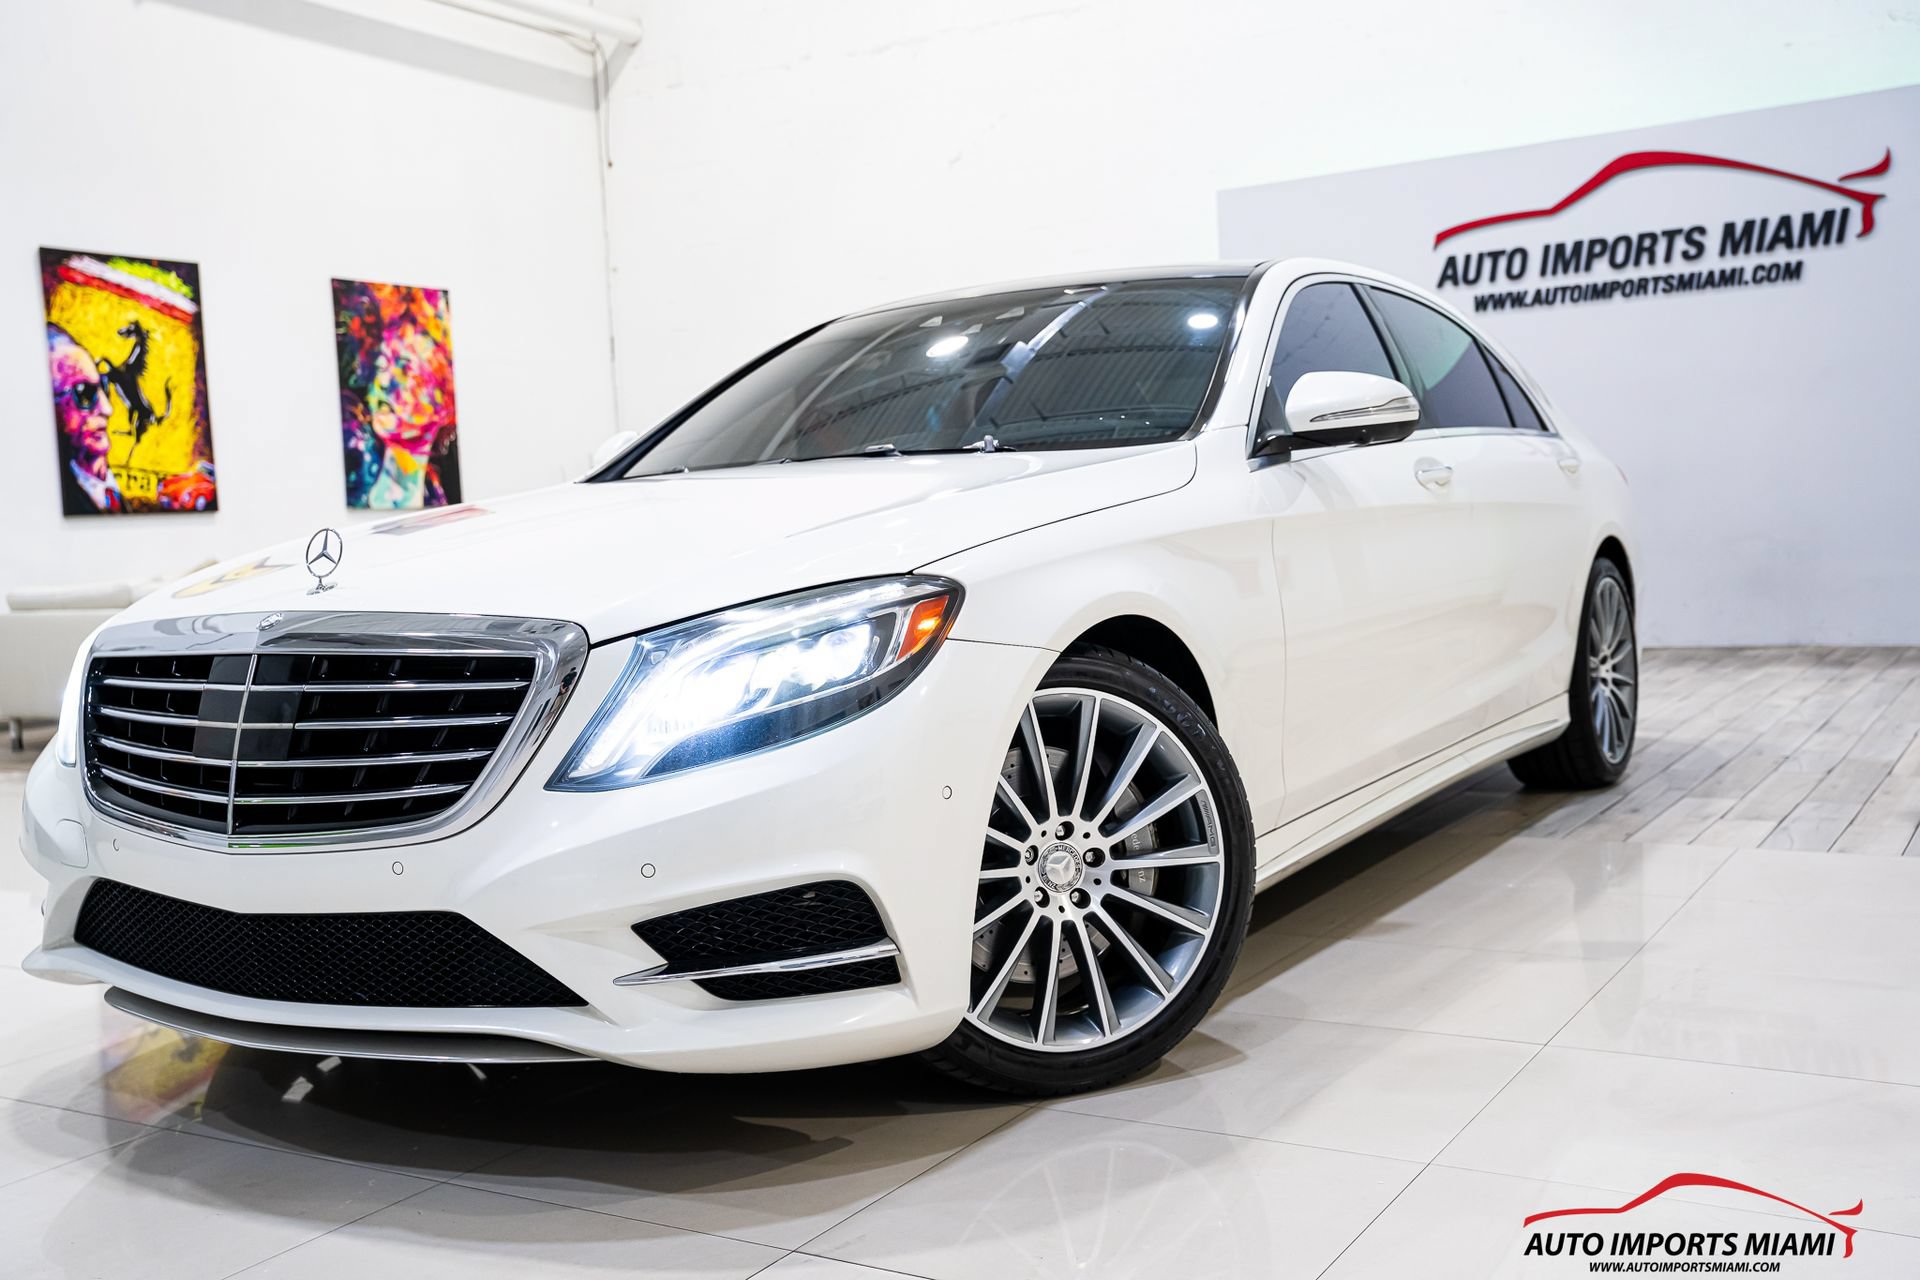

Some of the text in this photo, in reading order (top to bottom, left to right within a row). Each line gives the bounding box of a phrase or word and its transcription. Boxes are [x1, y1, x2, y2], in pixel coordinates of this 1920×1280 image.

[1437, 207, 1850, 289] AUTO IMPORTS MIAMI
[1474, 260, 1804, 312] WWW.AUTOIMPORTSMIAMI.COM
